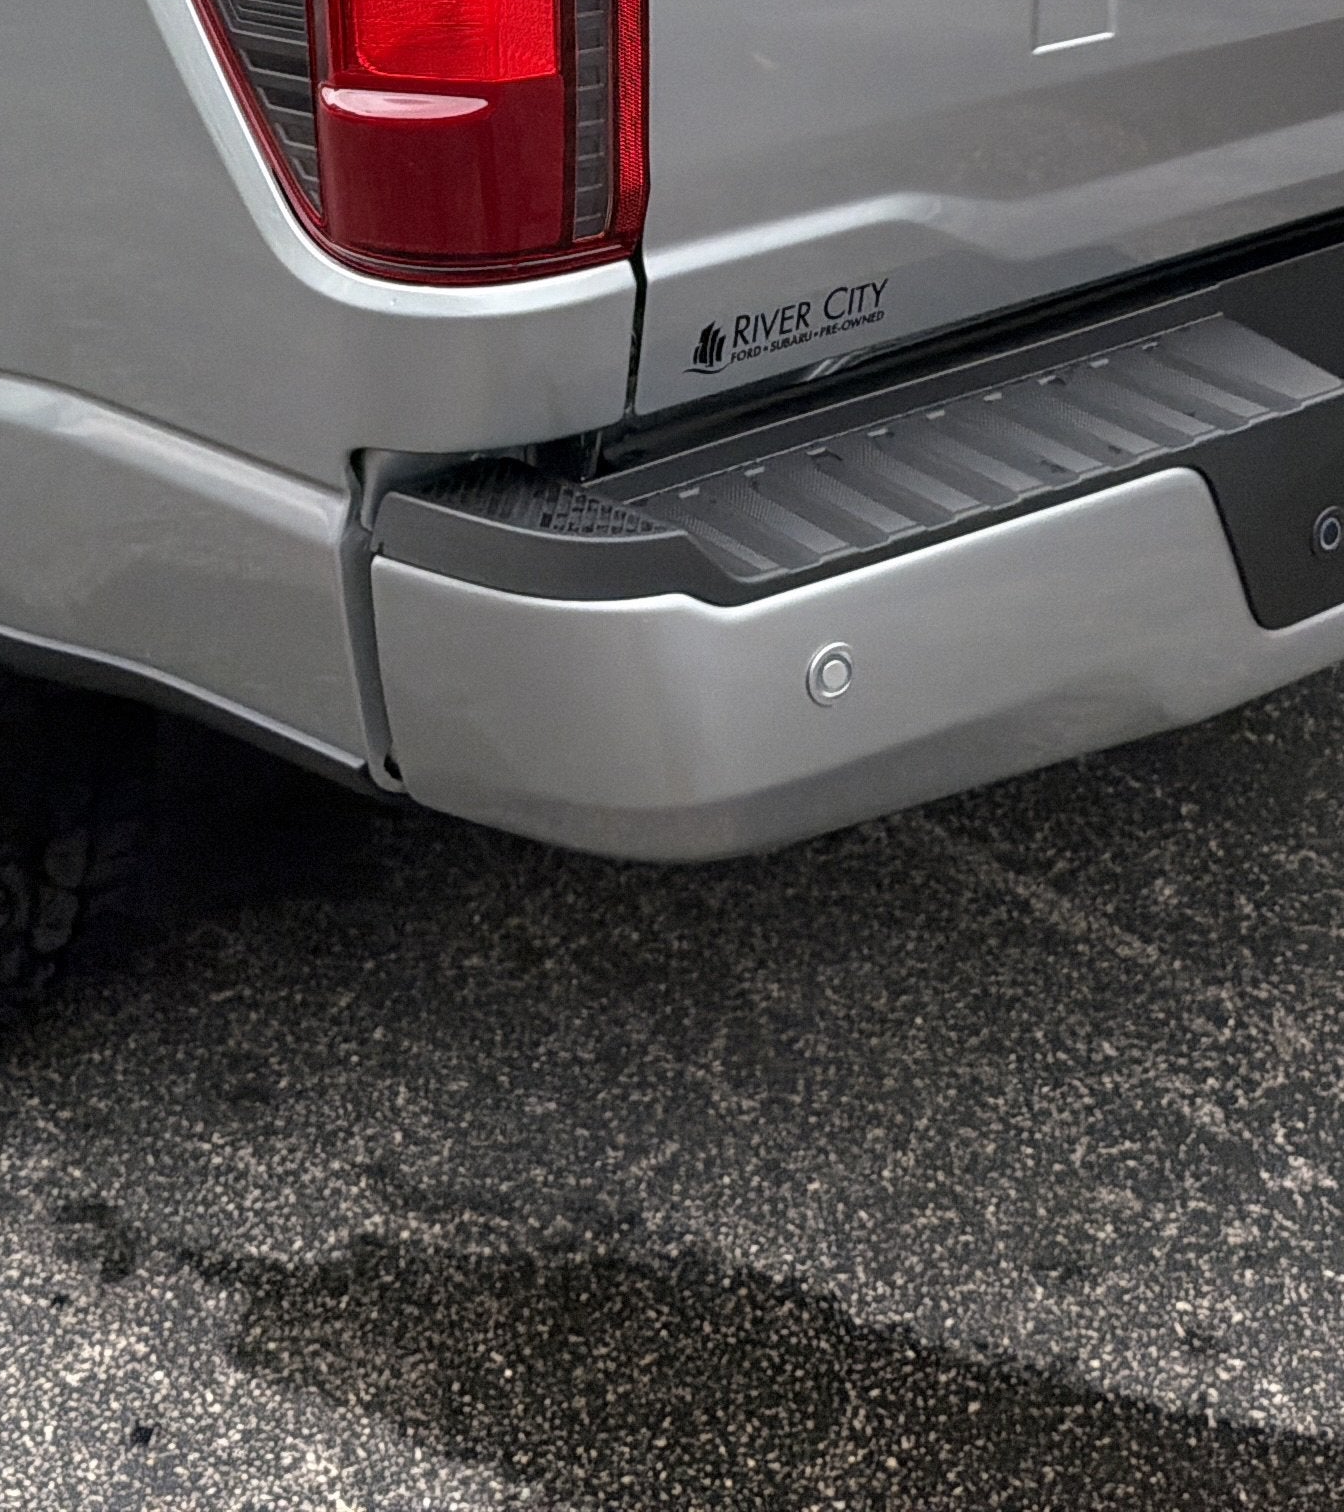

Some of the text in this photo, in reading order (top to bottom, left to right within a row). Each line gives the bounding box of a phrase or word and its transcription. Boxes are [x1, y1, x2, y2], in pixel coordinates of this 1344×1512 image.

[731, 310, 886, 363] FORD SUBARU PRE-OWNED
[732, 278, 889, 348] RIVER CITY
